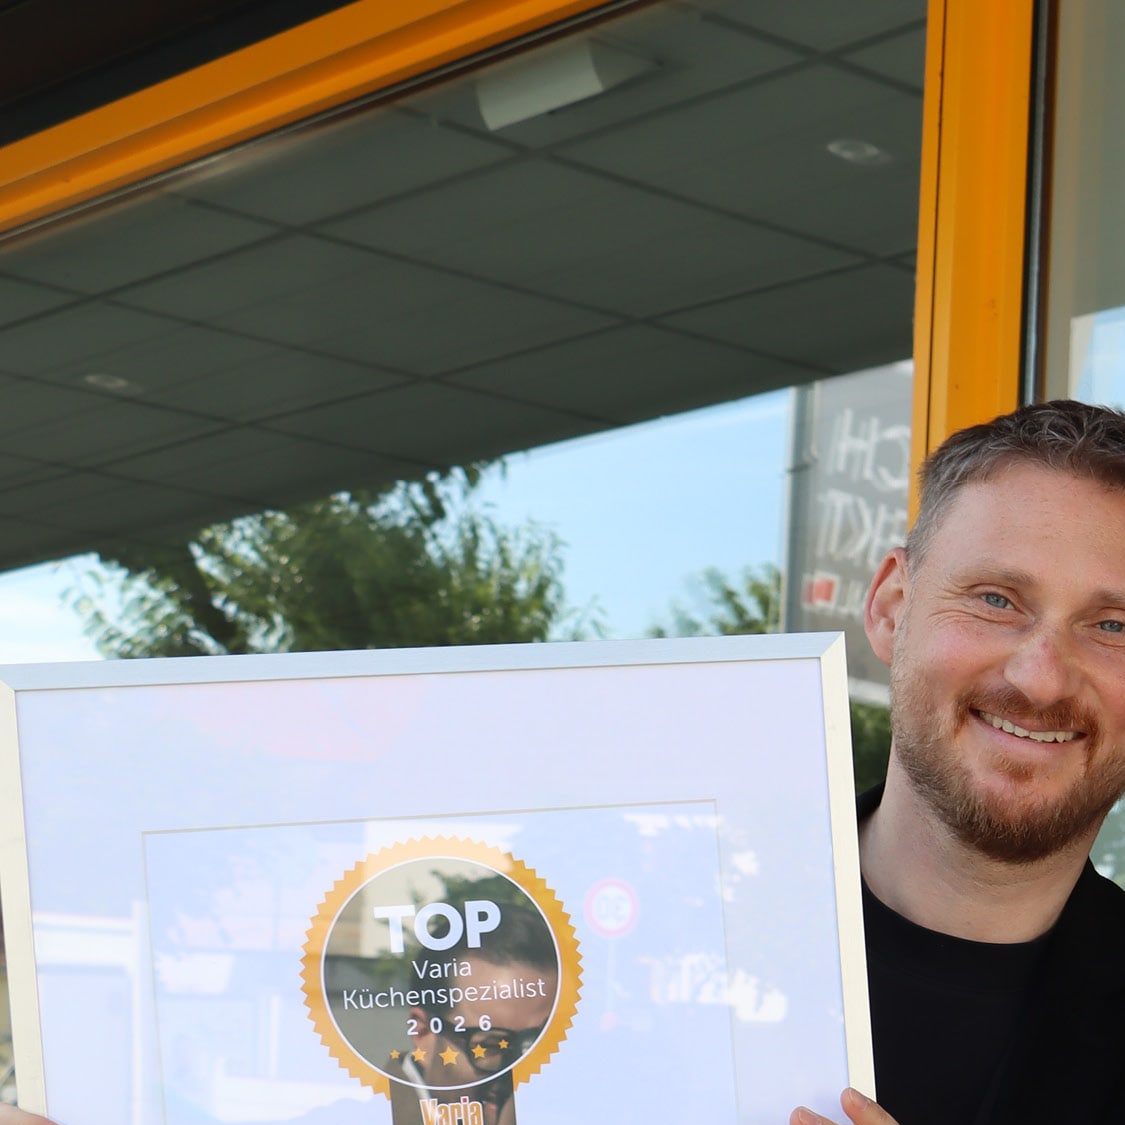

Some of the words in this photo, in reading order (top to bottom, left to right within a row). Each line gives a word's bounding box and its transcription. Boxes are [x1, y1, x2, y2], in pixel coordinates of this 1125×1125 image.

[374, 900, 501, 953] TOP
[412, 959, 472, 980] Varia
[343, 978, 546, 1010] Küchenspezialist
[407, 1015, 491, 1036] 2026
